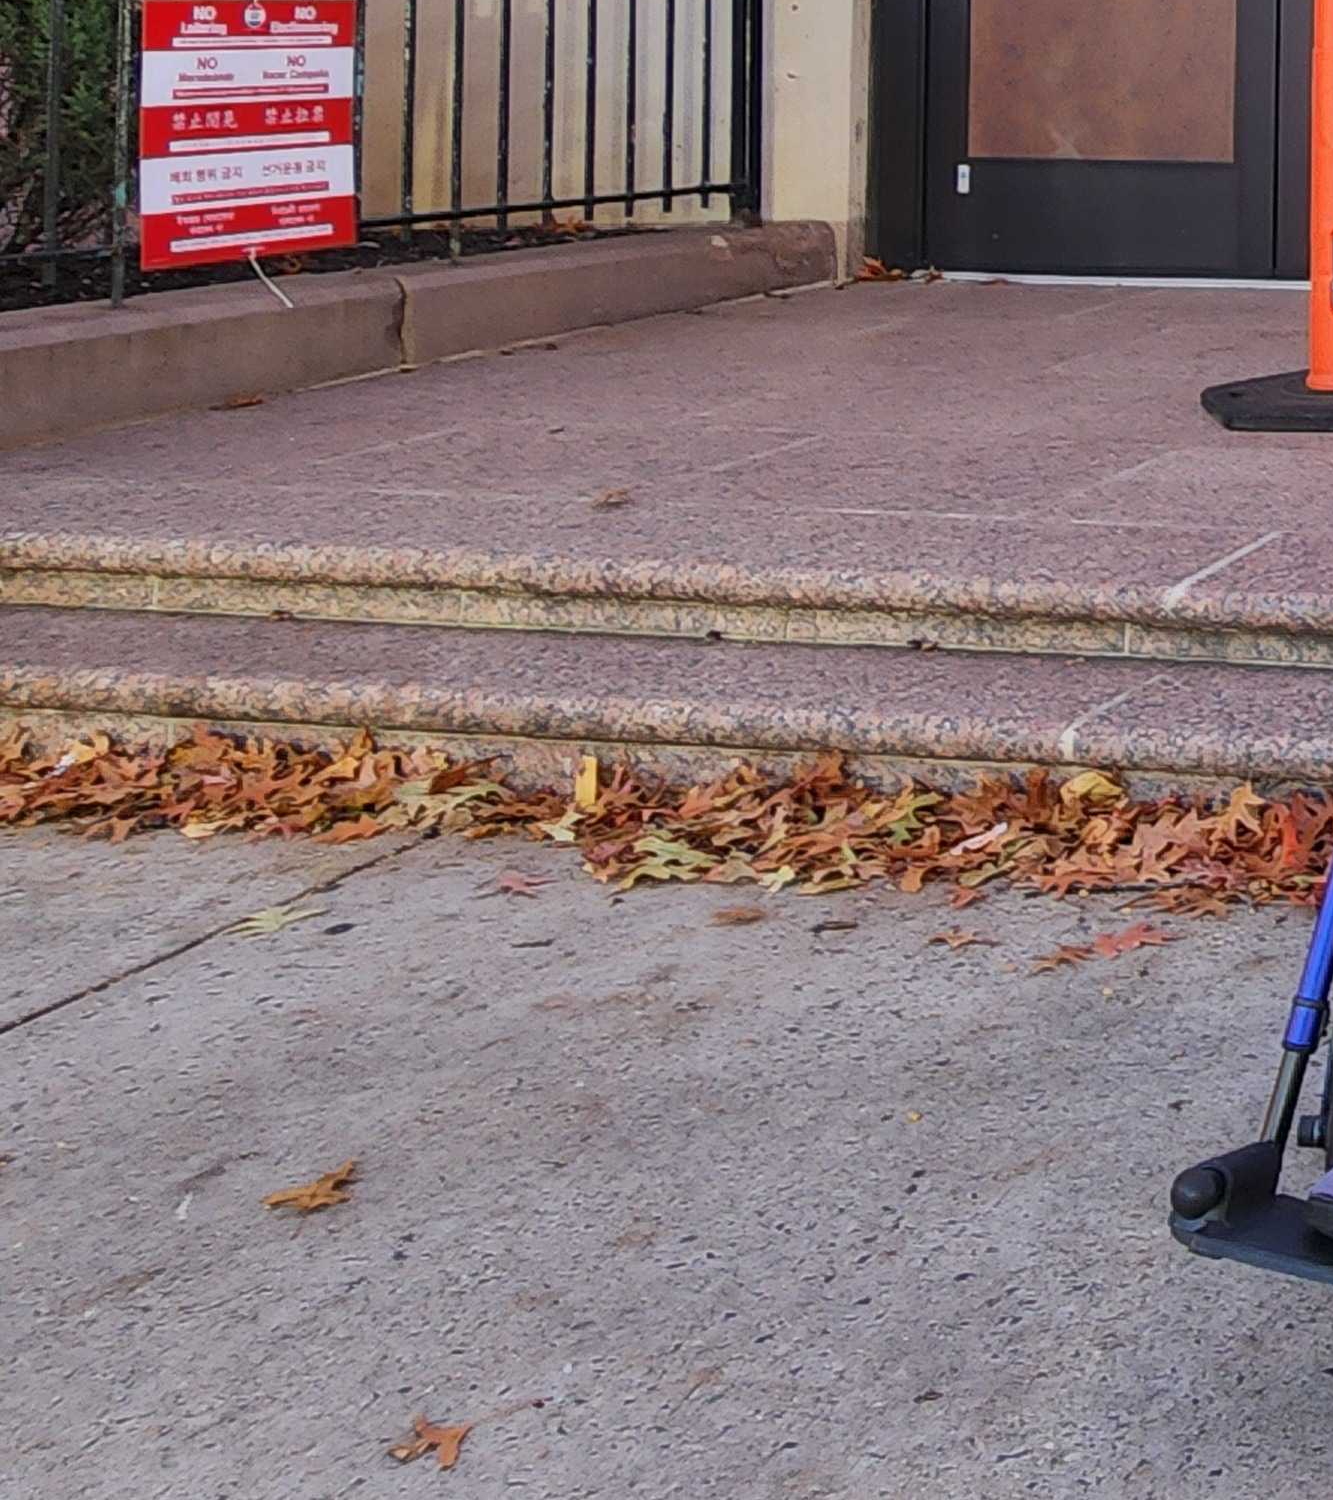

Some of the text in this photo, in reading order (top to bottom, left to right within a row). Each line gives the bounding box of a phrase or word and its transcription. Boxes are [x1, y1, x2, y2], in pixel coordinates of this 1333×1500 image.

[192, 5, 217, 20] NO
[294, 5, 317, 20] NO
[196, 56, 219, 70] NO
[286, 54, 307, 67] NO
